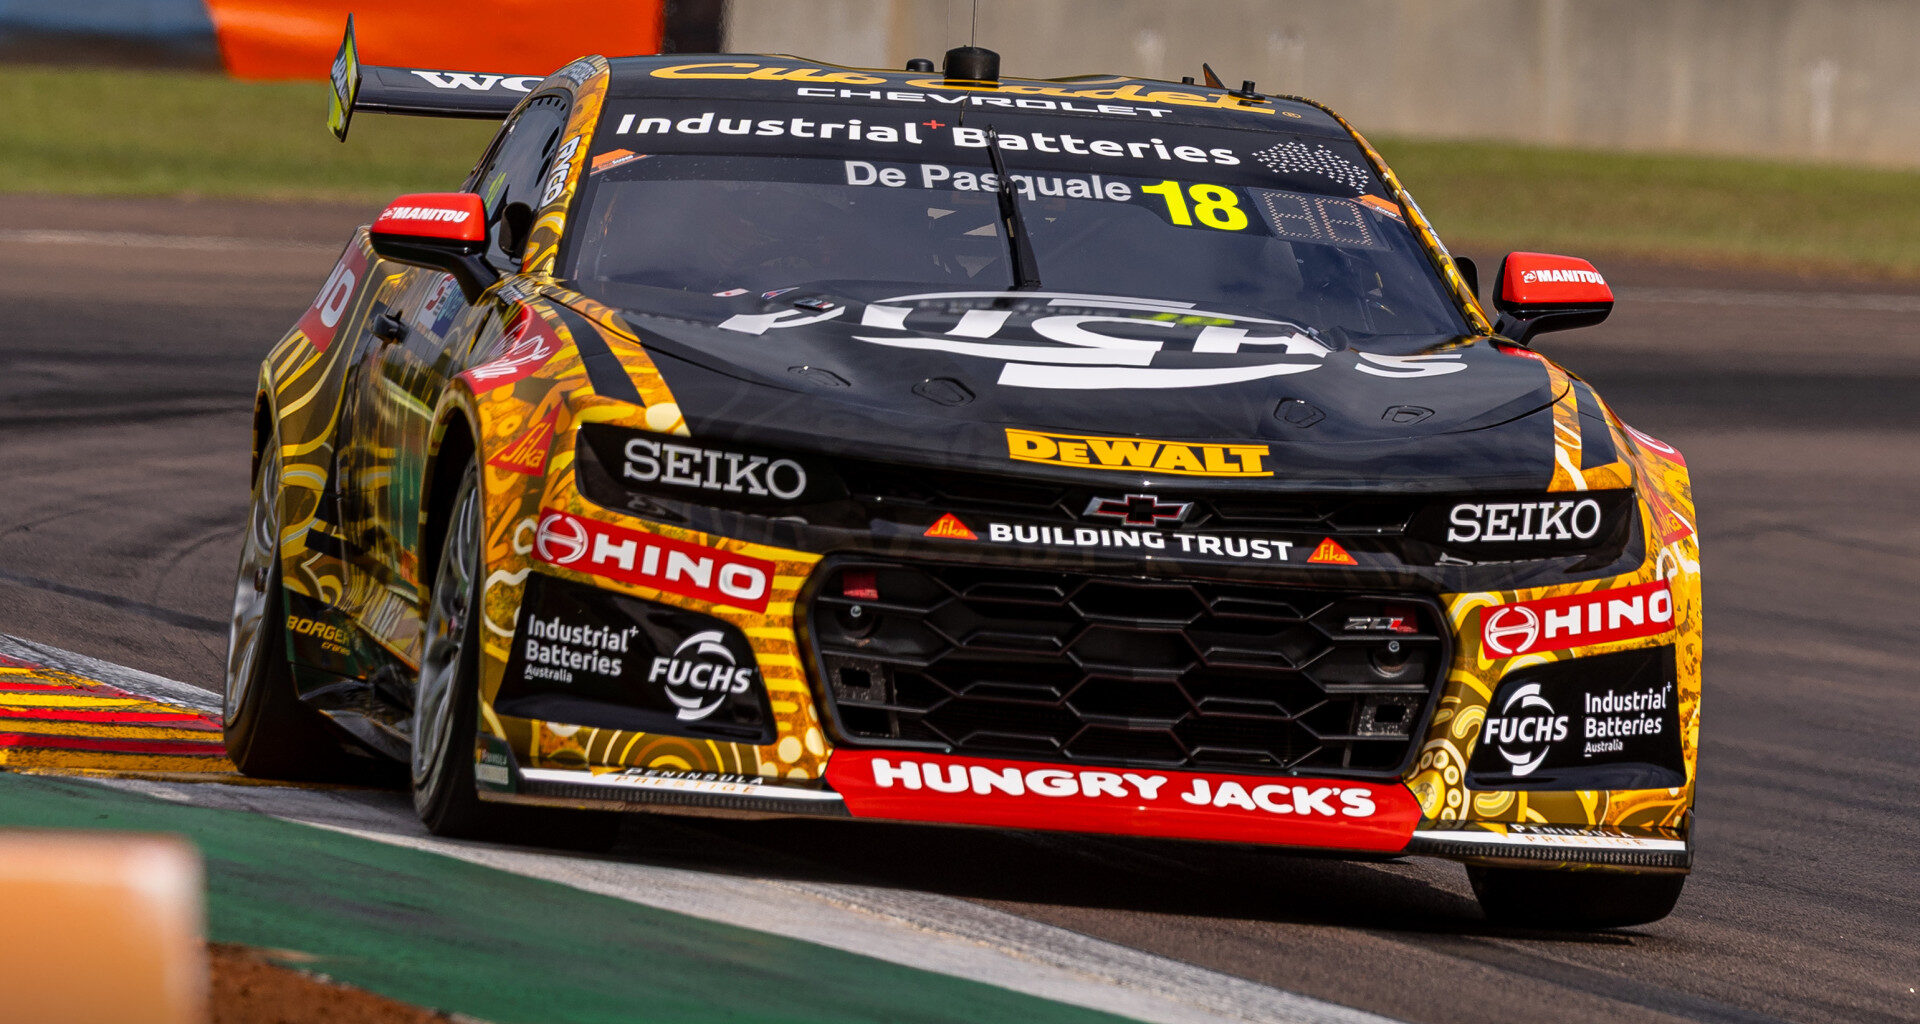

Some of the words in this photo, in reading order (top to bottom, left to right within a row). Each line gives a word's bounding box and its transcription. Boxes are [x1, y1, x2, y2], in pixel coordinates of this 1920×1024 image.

[650, 63, 887, 85] Cub
[797, 87, 1173, 118] CHEVROLET
[952, 125, 1240, 166] Batteries
[845, 160, 906, 188] De
[921, 163, 1132, 202] Pasquale
[1141, 179, 1249, 231] 18
[392, 206, 471, 224] MANITOU
[1537, 269, 1605, 285] MANITOU
[500, 421, 551, 467] Sika
[624, 438, 807, 500] SEIKO
[930, 519, 969, 539] Sika
[1447, 499, 1601, 543] SEIKO
[989, 523, 1164, 550] BUILDING
[1173, 533, 1294, 562] TRUST
[1313, 542, 1350, 564] Sika
[592, 532, 767, 601] HINO
[1543, 587, 1673, 639] HINO
[524, 639, 623, 677] Batteries
[524, 664, 573, 684] Australia
[648, 656, 753, 695] FUCHS
[1483, 715, 1570, 746] FUCHS
[1584, 712, 1663, 739] Batteries
[1584, 738, 1624, 754] Australia
[614, 774, 757, 794] PRESTIGE
[623, 767, 765, 786] PENINSULA
[870, 757, 1168, 800] HUNGRY
[1181, 777, 1377, 818] JACK'S
[1509, 822, 1636, 840] PENINSULA
